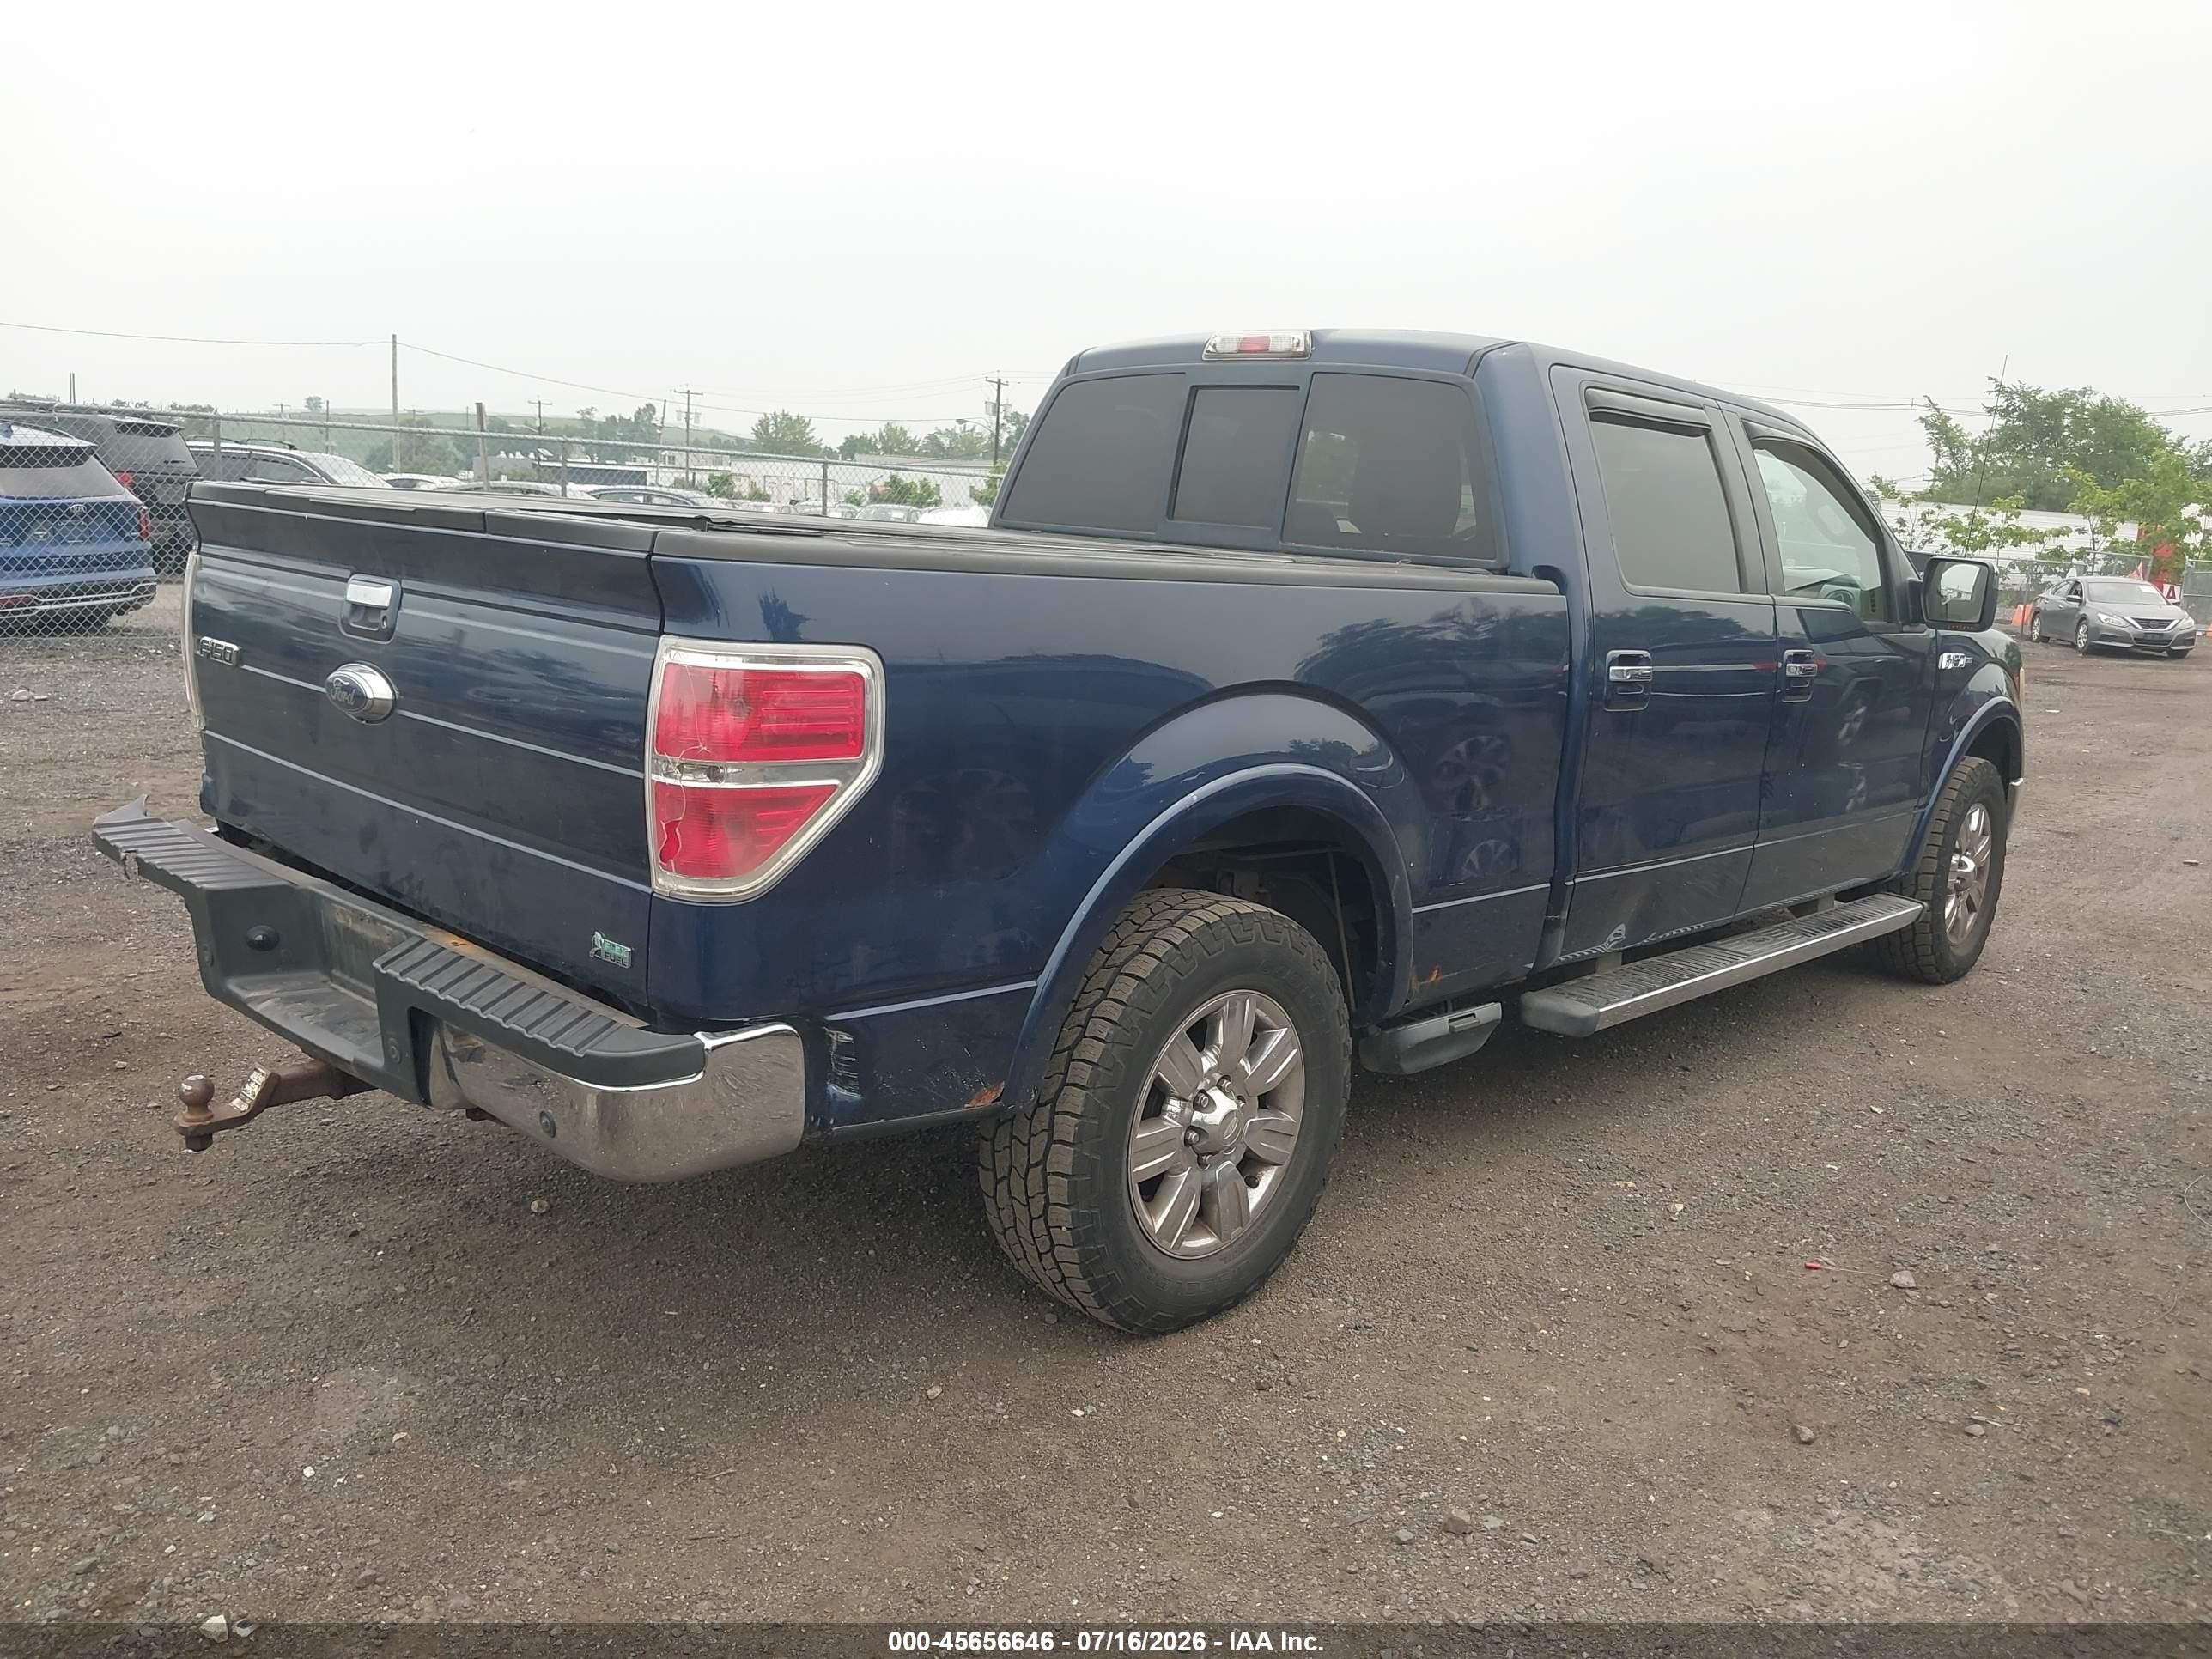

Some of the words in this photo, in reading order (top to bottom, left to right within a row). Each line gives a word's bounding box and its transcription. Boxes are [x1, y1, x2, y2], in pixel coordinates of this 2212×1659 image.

[331, 677, 357, 706] Ford
[604, 941, 628, 957] FLEX
[604, 951, 629, 967] FUEL
